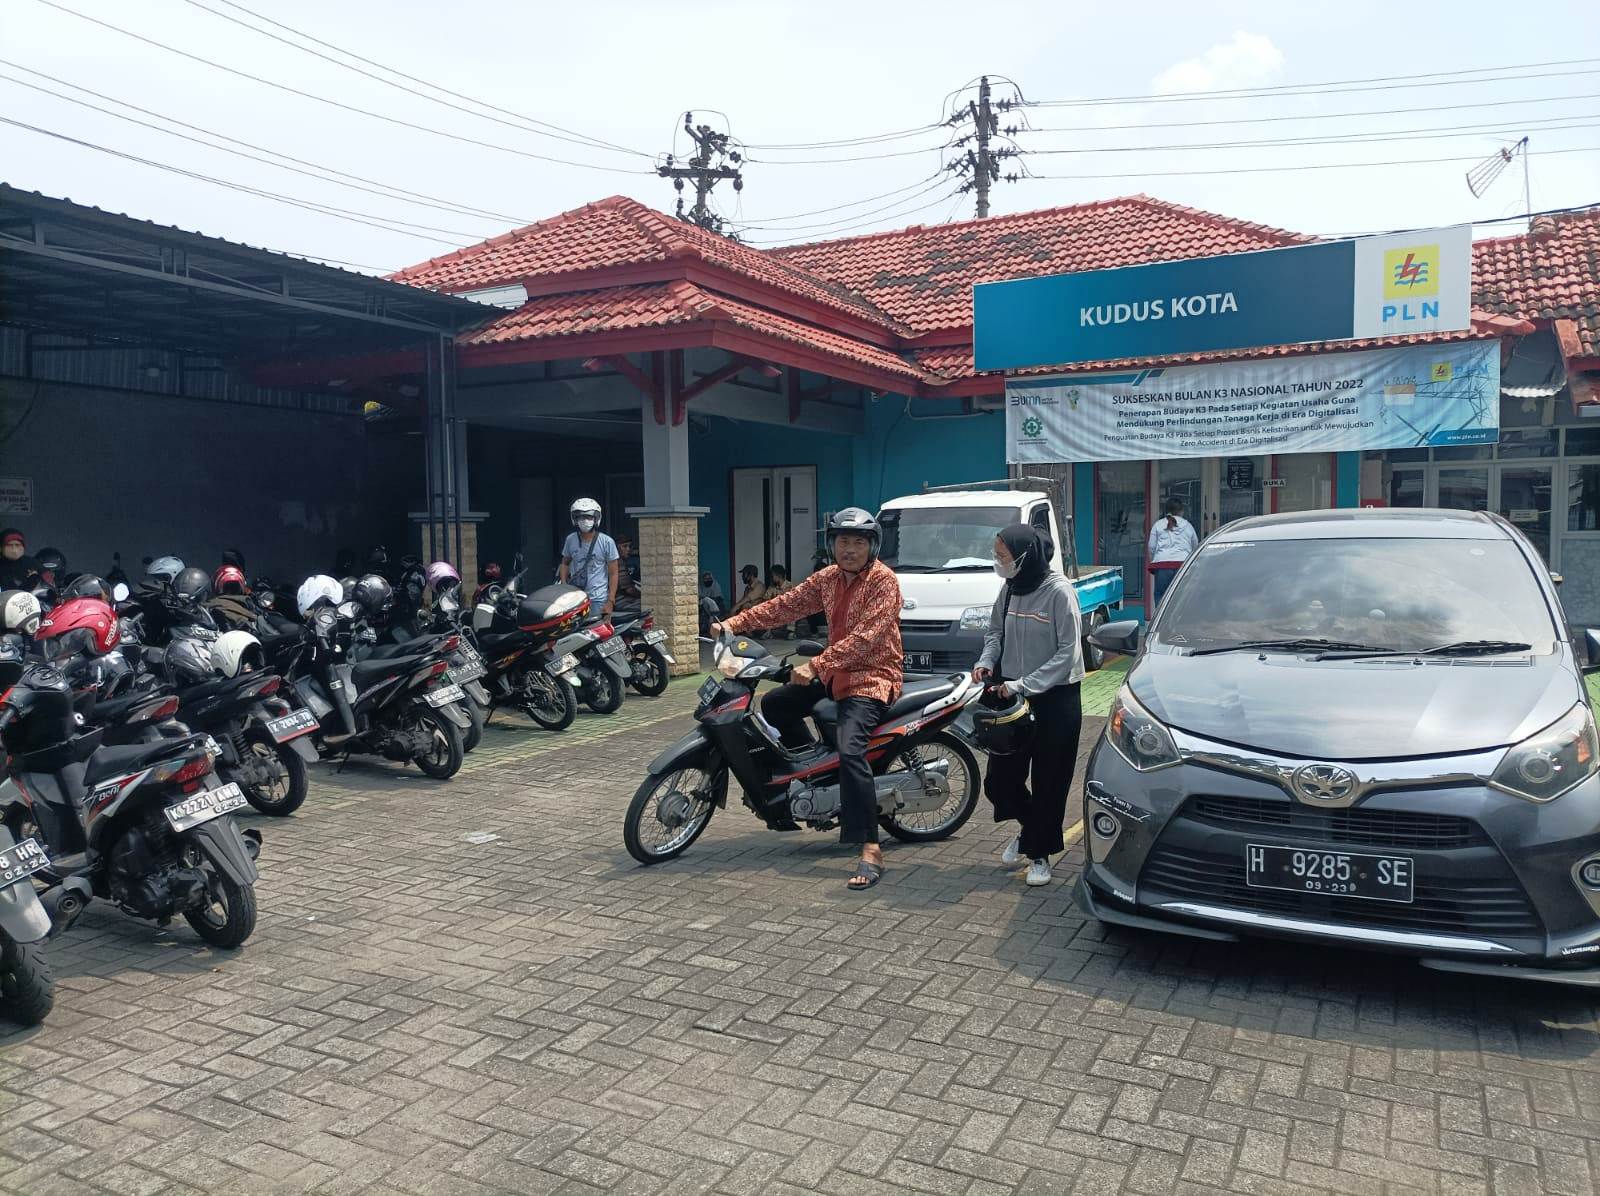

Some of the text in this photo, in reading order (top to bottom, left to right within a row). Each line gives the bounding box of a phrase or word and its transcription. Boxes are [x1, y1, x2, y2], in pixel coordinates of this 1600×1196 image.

[1080, 292, 1238, 327] KUDUS KOTA
[1382, 301, 1440, 323] PLN
[1112, 378, 1364, 405] SUKSESKAN BULAN K3 NASIONAL TAHUN 2022
[1116, 406, 1359, 428] Mendukung Perlindungan Tenaga Kerja di Era Digitalisasi
[1118, 395, 1356, 418] Penerapan Budaya K3 Pada Setiap Kegiatan Usaha Guna
[1104, 420, 1374, 442] Penguatan Budaya K3 Pada Setiap Proses Bisnis Kelistrikan untuk Mewujudkan
[1180, 435, 1288, 447] Zero Accident di Era Digitalisasi
[169, 808, 181, 821] K
[15, 843, 39, 861] HR
[1251, 848, 1408, 887] H 9285 SE
